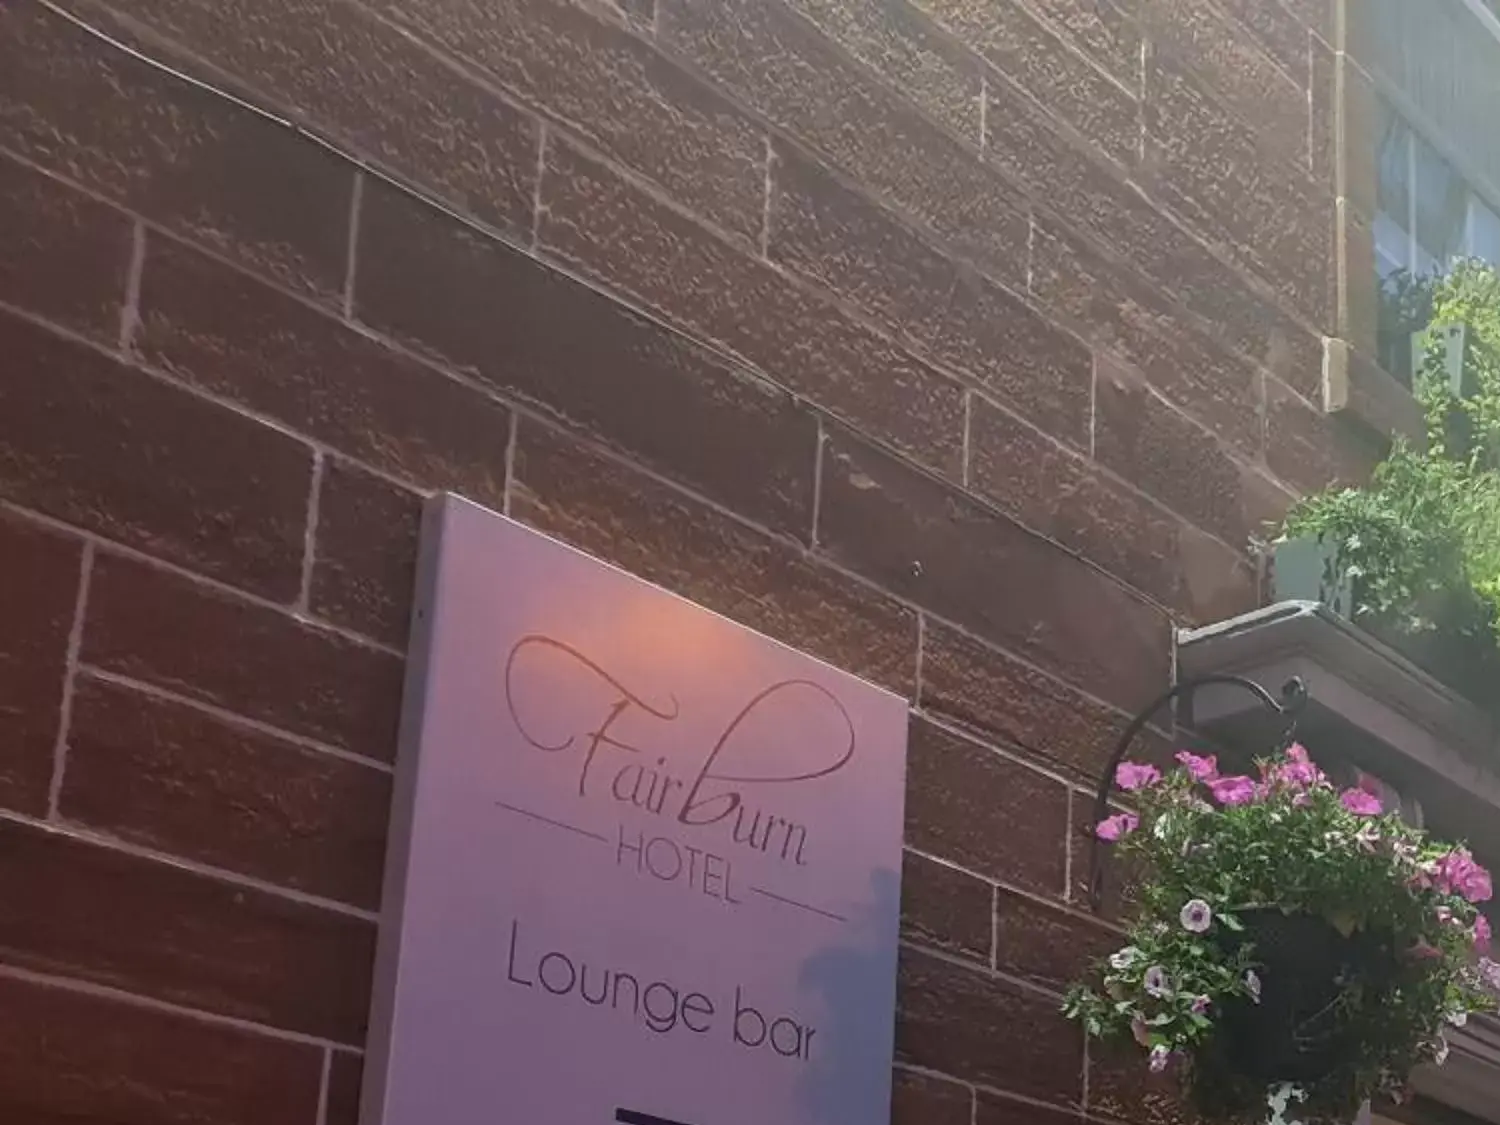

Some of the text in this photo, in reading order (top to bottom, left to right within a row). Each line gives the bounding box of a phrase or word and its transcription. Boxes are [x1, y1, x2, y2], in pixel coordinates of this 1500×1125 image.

[614, 825, 742, 904] HOTEL
[507, 920, 816, 1060] Lounge bar
